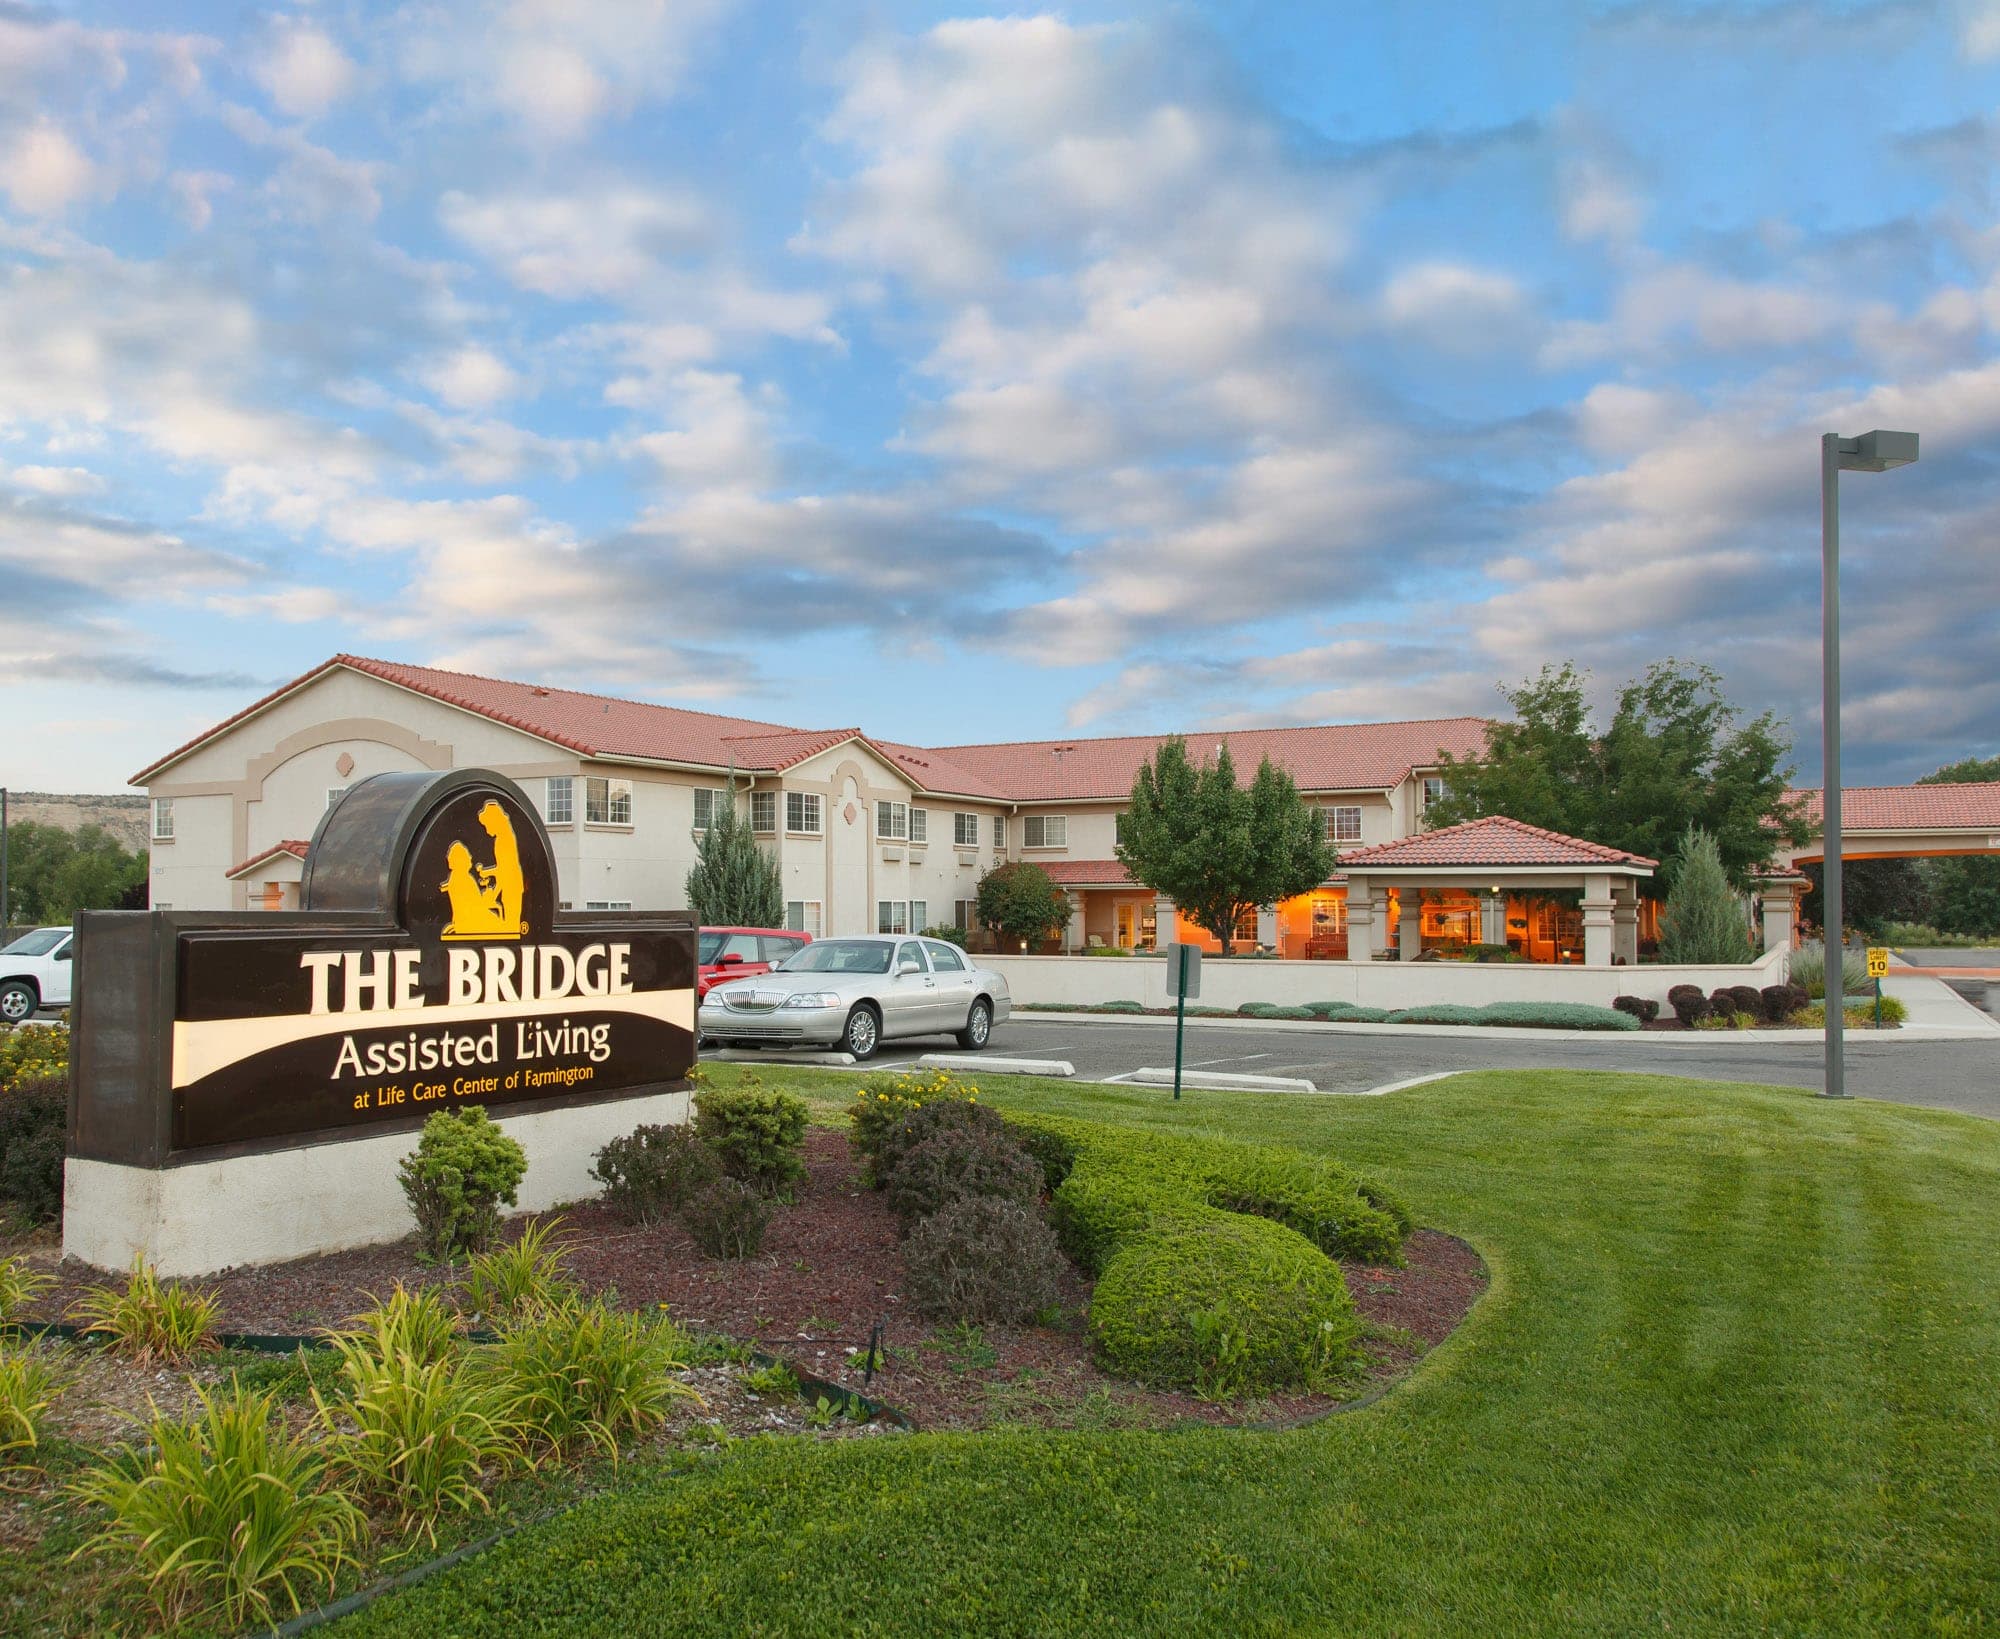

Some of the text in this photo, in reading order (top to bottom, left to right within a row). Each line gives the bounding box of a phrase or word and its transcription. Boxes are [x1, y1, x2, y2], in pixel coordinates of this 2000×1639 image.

[300, 943, 633, 1015] THE BRIDGE
[1869, 961, 1885, 970] 10
[330, 1023, 499, 1080] Assisted
[353, 1065, 594, 1109] at Life Care Center of Farmington
